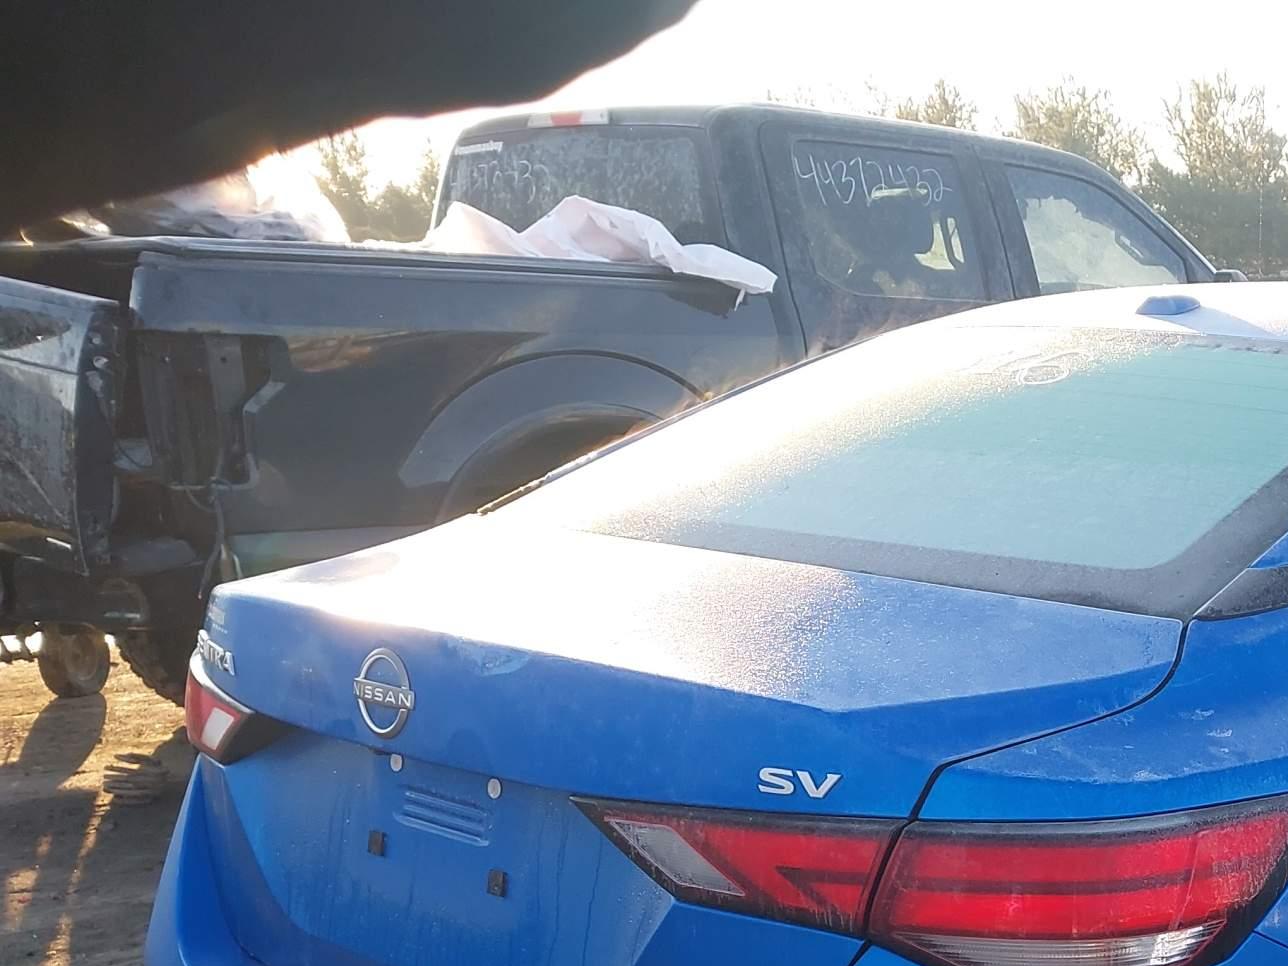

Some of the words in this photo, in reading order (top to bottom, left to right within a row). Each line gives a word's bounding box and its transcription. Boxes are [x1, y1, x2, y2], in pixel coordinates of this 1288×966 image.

[794, 154, 953, 207] 44372432
[353, 681, 412, 707] NISSAN
[757, 767, 842, 798] SV
